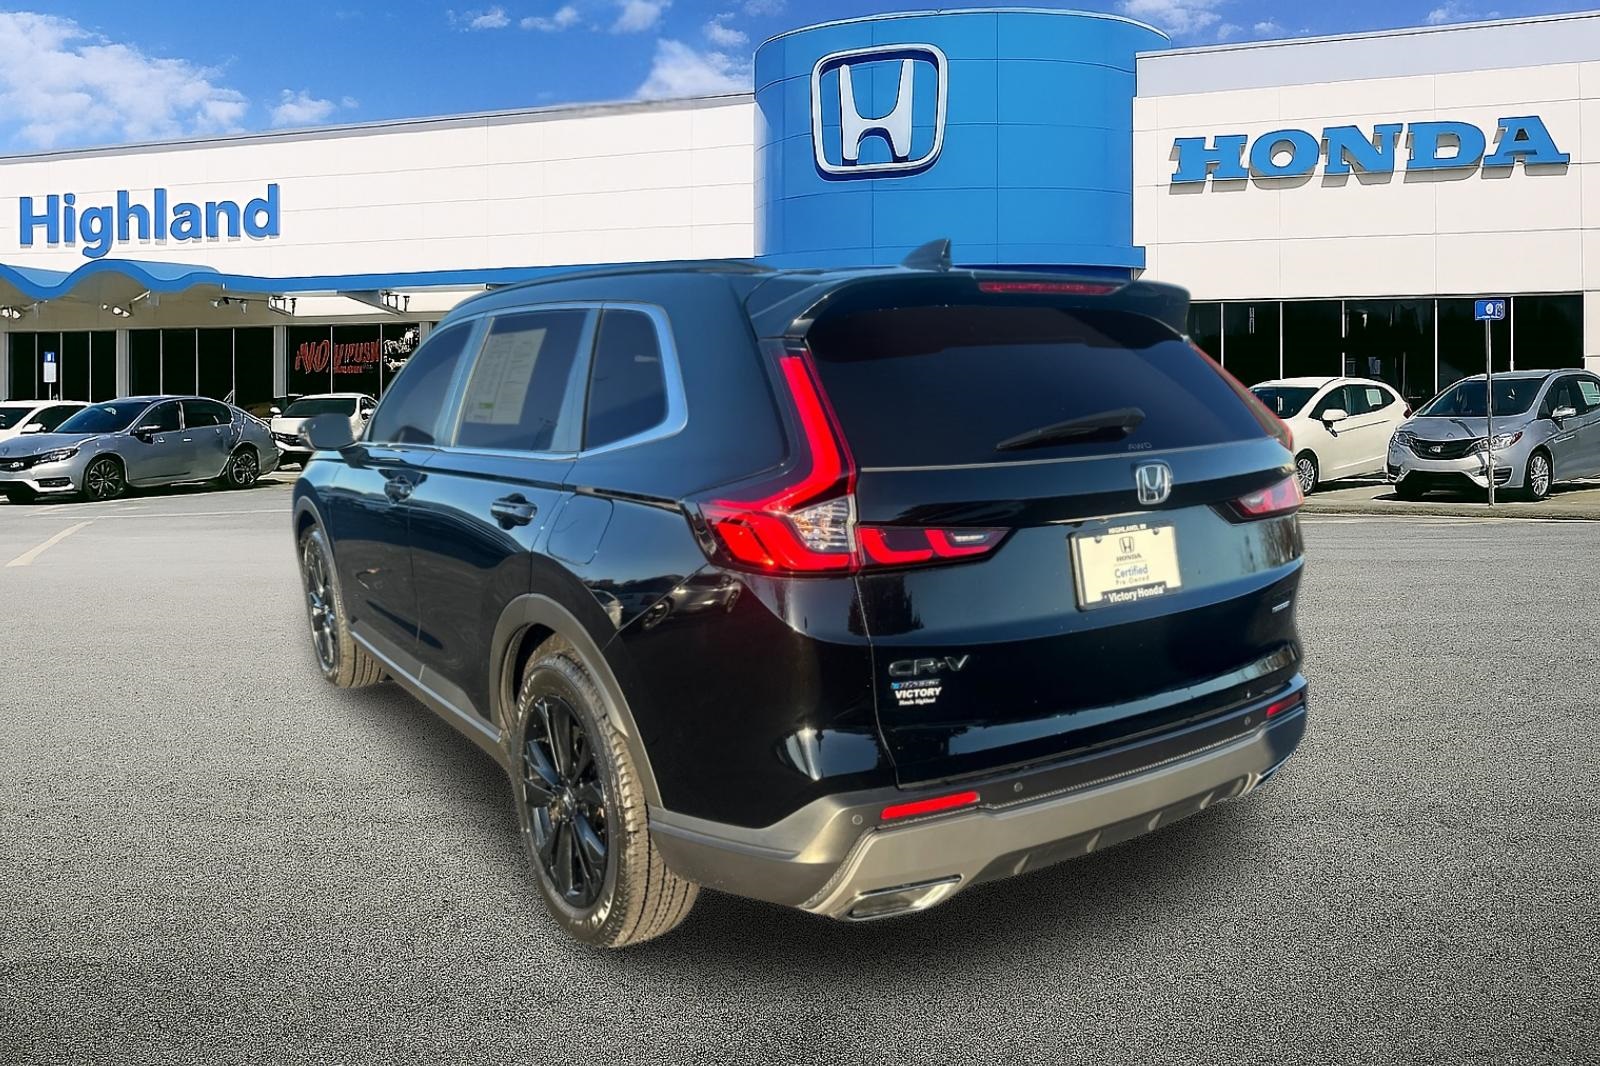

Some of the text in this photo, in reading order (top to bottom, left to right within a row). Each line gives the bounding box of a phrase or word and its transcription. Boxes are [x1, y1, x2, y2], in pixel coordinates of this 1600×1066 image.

[1171, 115, 1570, 183] HONDA
[19, 183, 280, 258] Highland
[1128, 442, 1152, 450] AWD
[1116, 553, 1142, 562] HONDA
[1115, 565, 1149, 578] Certified
[1108, 590, 1137, 603] Victory
[888, 655, 969, 676] CR-V
[895, 686, 942, 699] VICTORY
